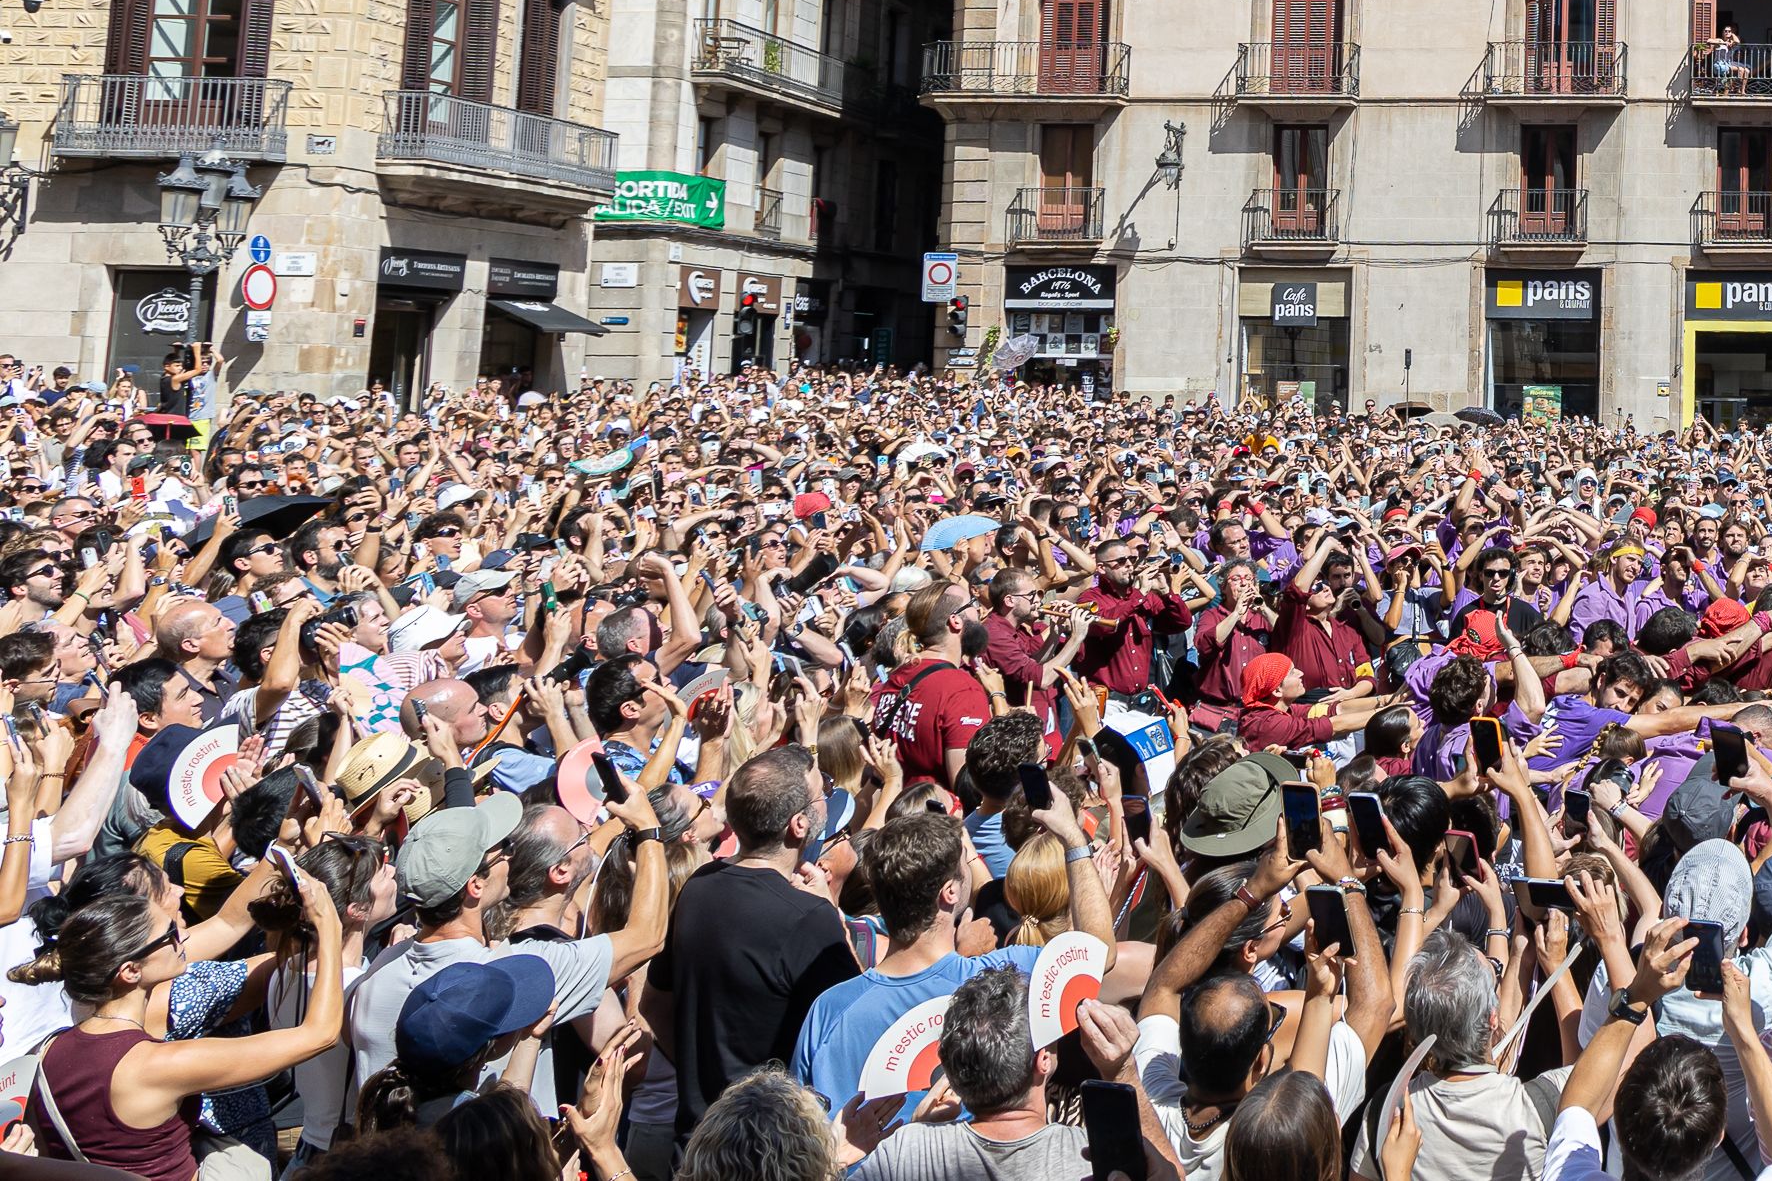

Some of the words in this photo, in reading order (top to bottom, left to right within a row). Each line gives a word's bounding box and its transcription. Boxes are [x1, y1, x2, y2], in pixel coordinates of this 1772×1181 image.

[594, 199, 662, 216] ALIDA
[673, 201, 697, 219] EXIT
[1019, 267, 1102, 295] BARCELONA
[1050, 280, 1071, 290] 1976
[1527, 280, 1591, 307] pans
[1559, 300, 1564, 309] &
[1564, 300, 1590, 309] COMPANY
[140, 301, 191, 321] Vicens
[1275, 303, 1314, 321] pans
[1758, 302, 1764, 311] &
[188, 739, 221, 770] rostint
[181, 770, 198, 808] m'estic
[1039, 965, 1059, 1018] m'estic
[1056, 946, 1089, 969] rostint
[885, 1022, 926, 1071] m'estic
